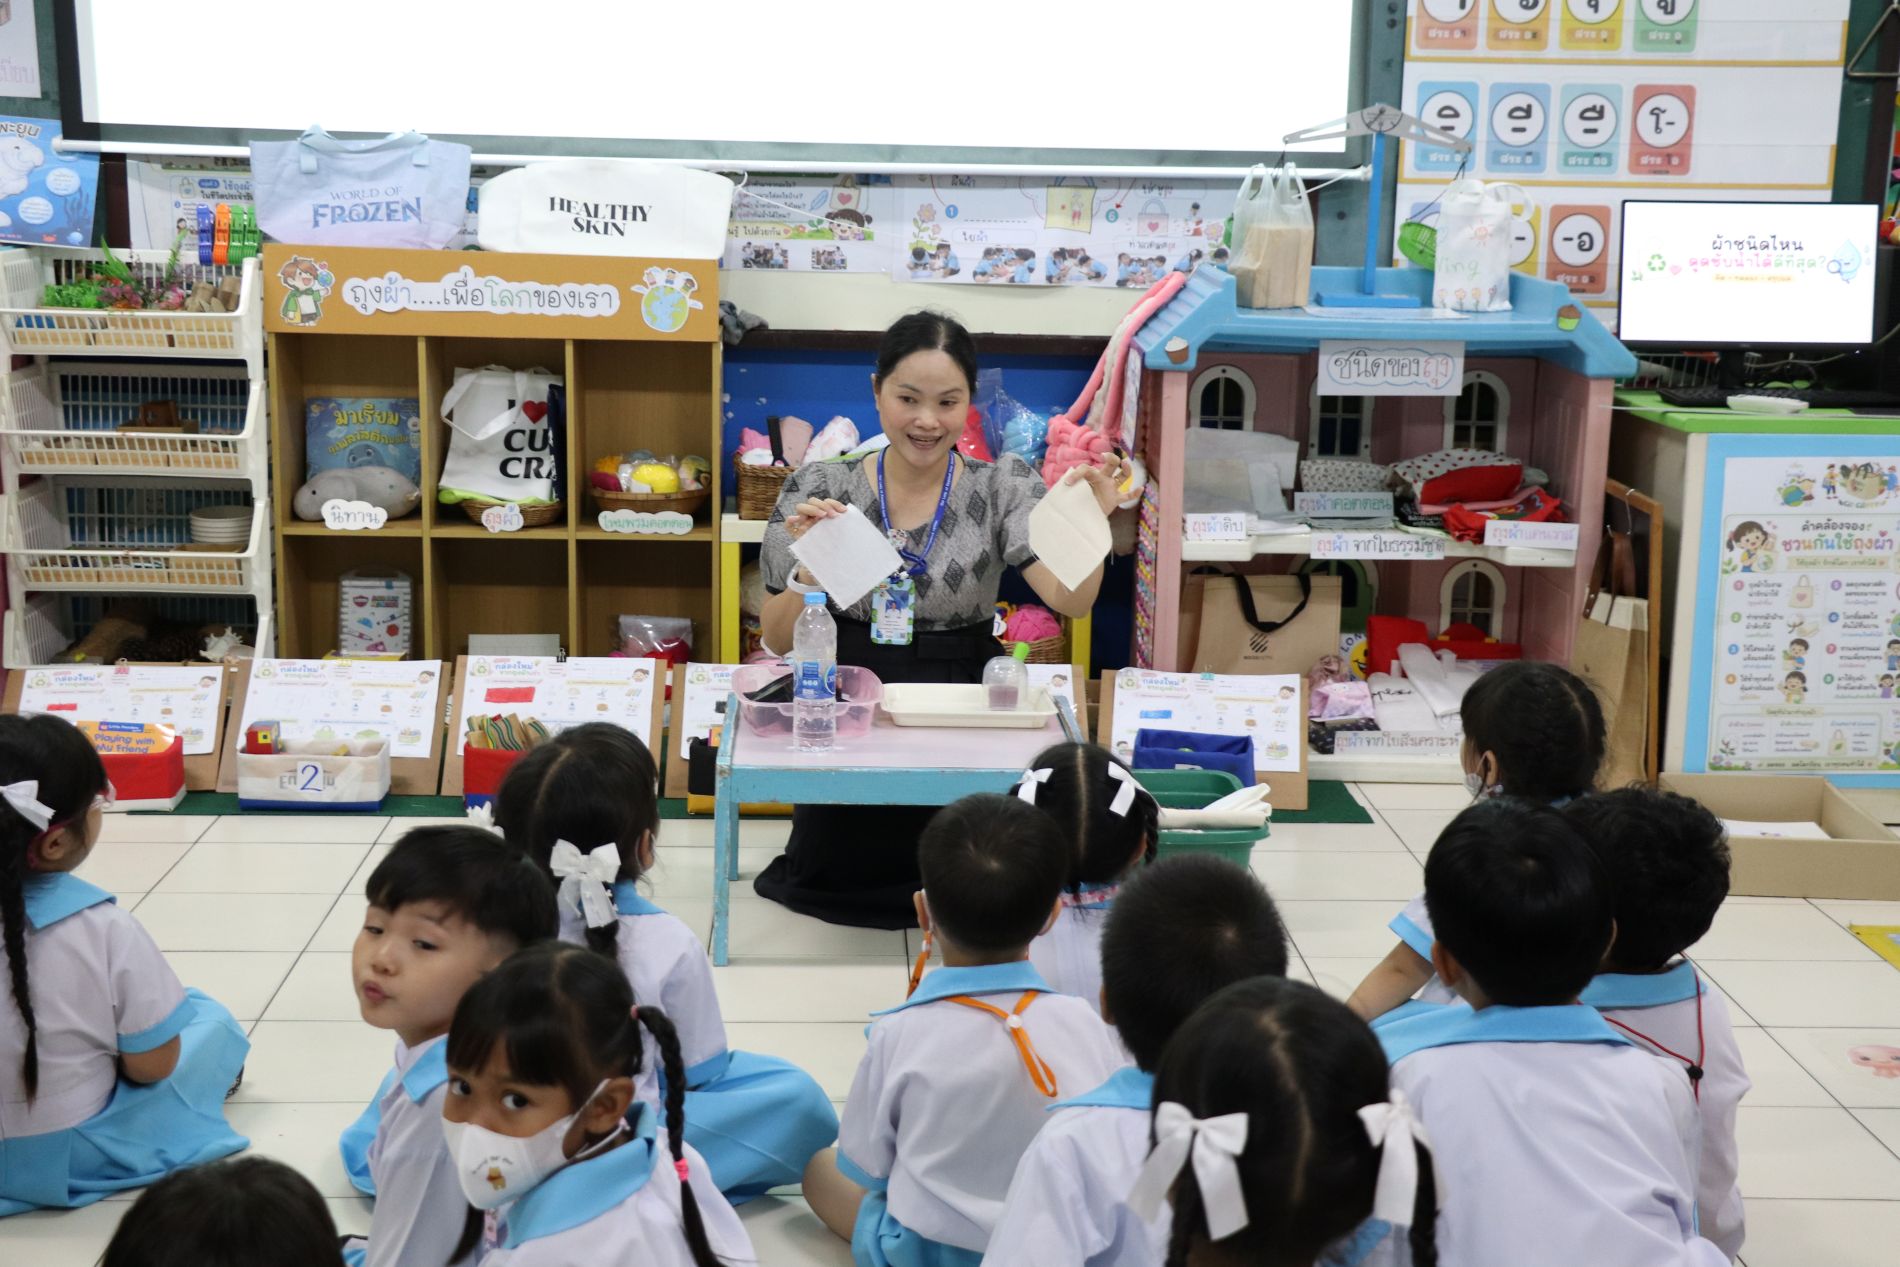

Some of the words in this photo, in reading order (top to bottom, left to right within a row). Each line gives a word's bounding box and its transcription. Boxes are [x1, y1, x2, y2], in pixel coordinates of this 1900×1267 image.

[330, 188, 380, 201] WORLD
[384, 185, 402, 196] OF
[312, 197, 422, 229] FROZEN
[549, 197, 652, 222] HEALTHY
[572, 216, 626, 237] SKIN
[1712, 235, 1804, 251] ผ้าชนิดไหน
[333, 402, 400, 426] มาเรียม
[331, 505, 380, 523] นิทาน
[484, 505, 521, 532] ถุงผ้า
[1802, 518, 1865, 531] คำคล้องจอง
[1192, 514, 1243, 537] ถุงผ้าดิบ
[1782, 533, 1894, 554] ชวนกันใช้ถุงผ้า
[94, 733, 132, 745] Playing
[135, 737, 156, 746] with
[95, 743, 113, 753] My
[116, 744, 149, 754] Friend
[300, 764, 323, 792] 2
